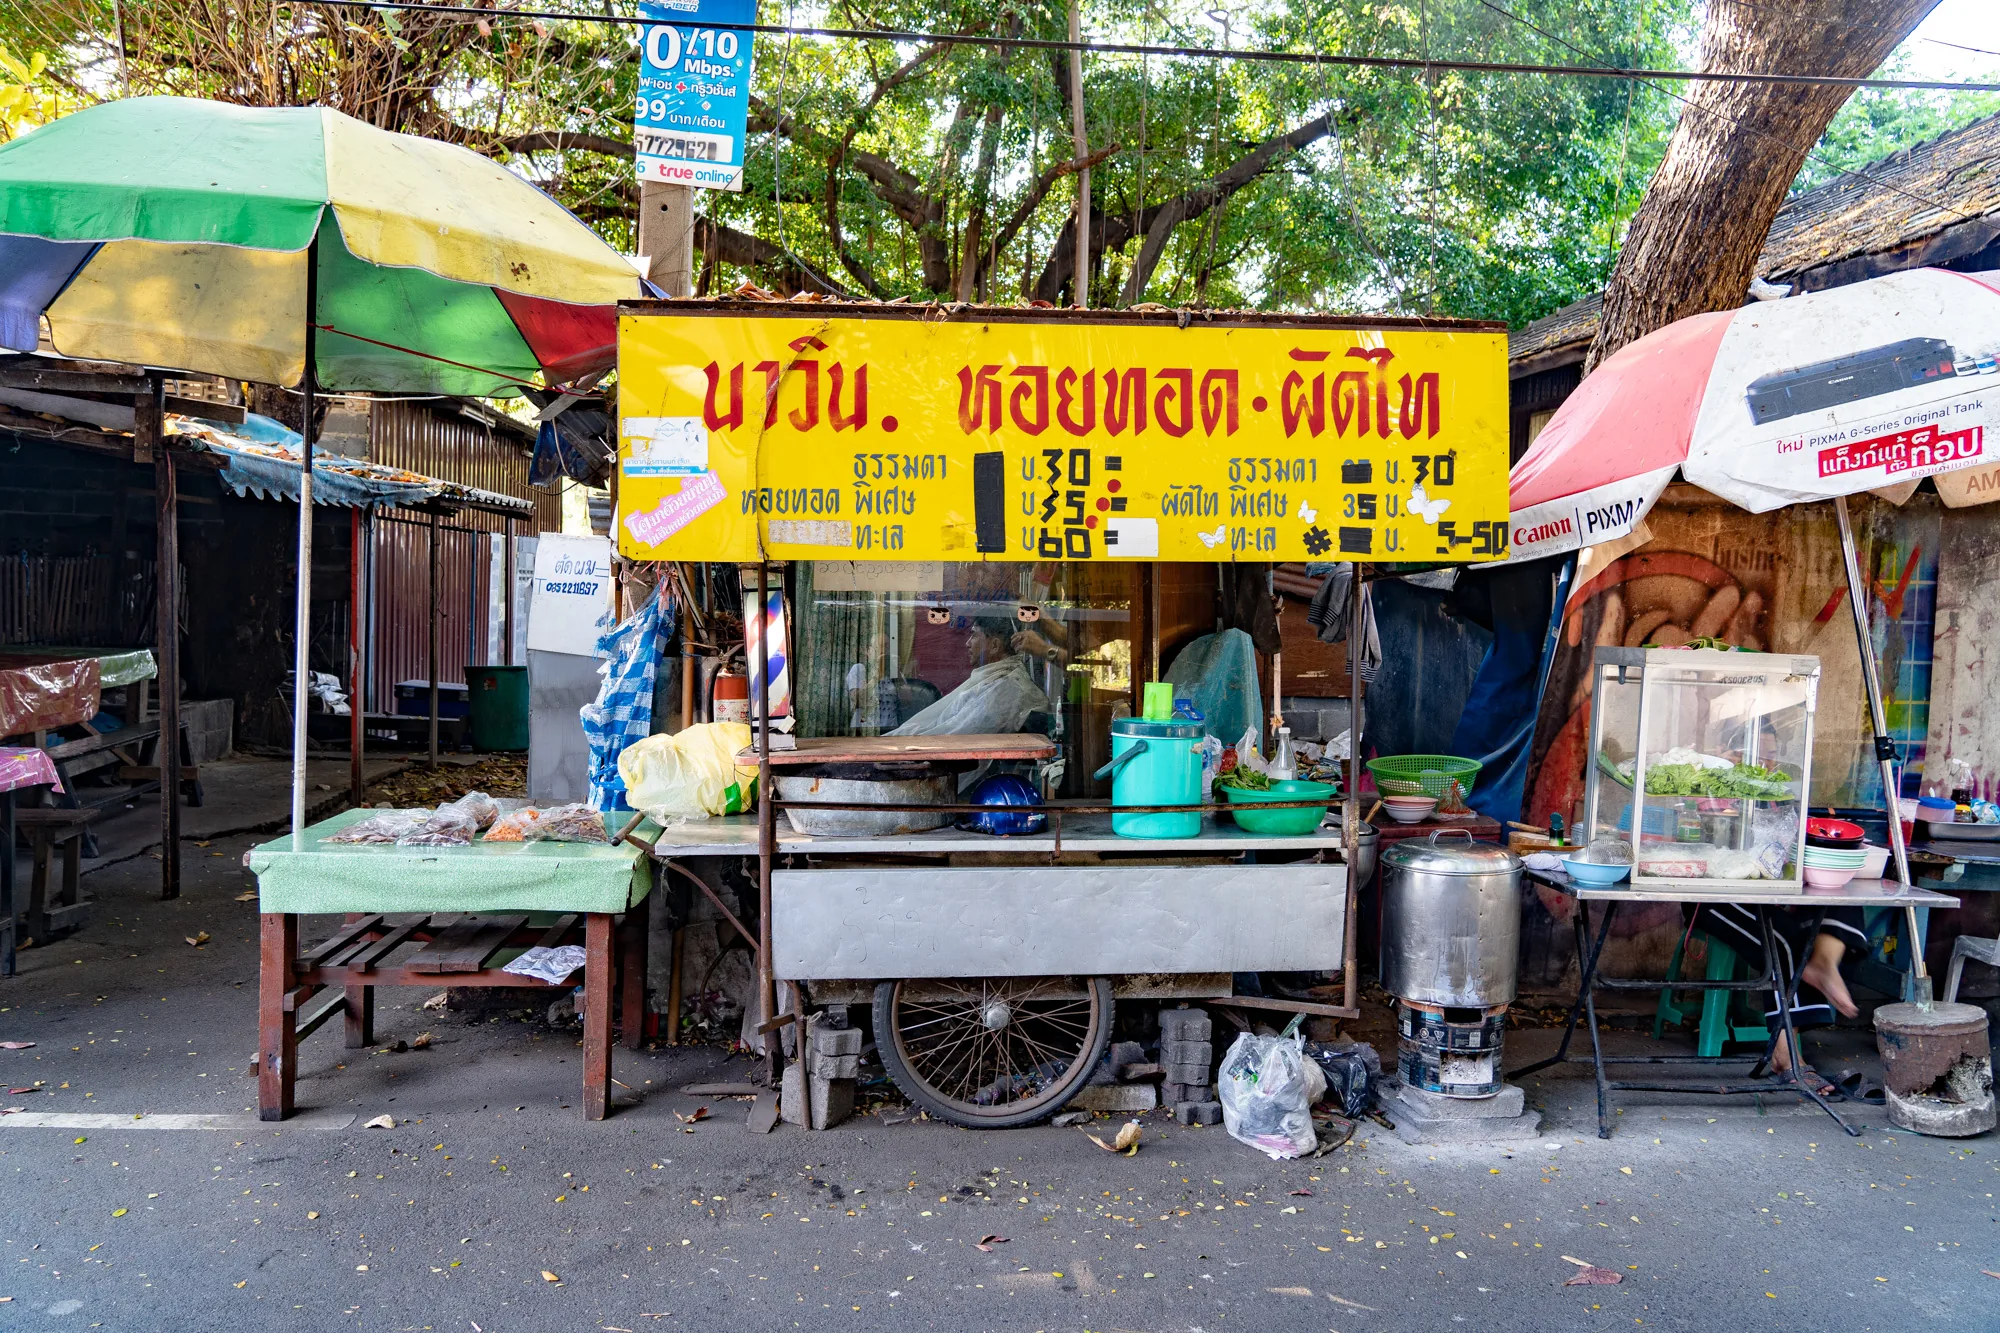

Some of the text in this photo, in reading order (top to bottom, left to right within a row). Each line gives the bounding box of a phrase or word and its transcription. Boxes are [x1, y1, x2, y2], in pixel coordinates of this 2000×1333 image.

[684, 58, 736, 79] Mbps.
[669, 113, 726, 129] บาท/เดือน
[956, 364, 1240, 438] หอยทอด
[1280, 347, 1441, 441] ผัดไท
[1828, 375, 1854, 384] Canon
[1776, 400, 1983, 455] ใหม่ PIXMA G-Series Original Tank
[1911, 427, 1980, 467] ท็อป
[854, 454, 947, 479] ธรรมดา
[1042, 448, 1091, 487] 30
[1228, 457, 1317, 483] ธรรมดา
[1412, 455, 1455, 485] 30
[741, 487, 840, 515] หอยทอด
[852, 481, 916, 515] พิเศษ
[1161, 484, 1219, 517] ผัดไท
[1228, 484, 1288, 517] พิเศษ
[856, 525, 904, 550] ทะเล
[1038, 527, 1092, 558] 60
[1231, 526, 1276, 551] ทะเล
[1513, 517, 1572, 546] Canon
[1555, 541, 1575, 550] Alwys
